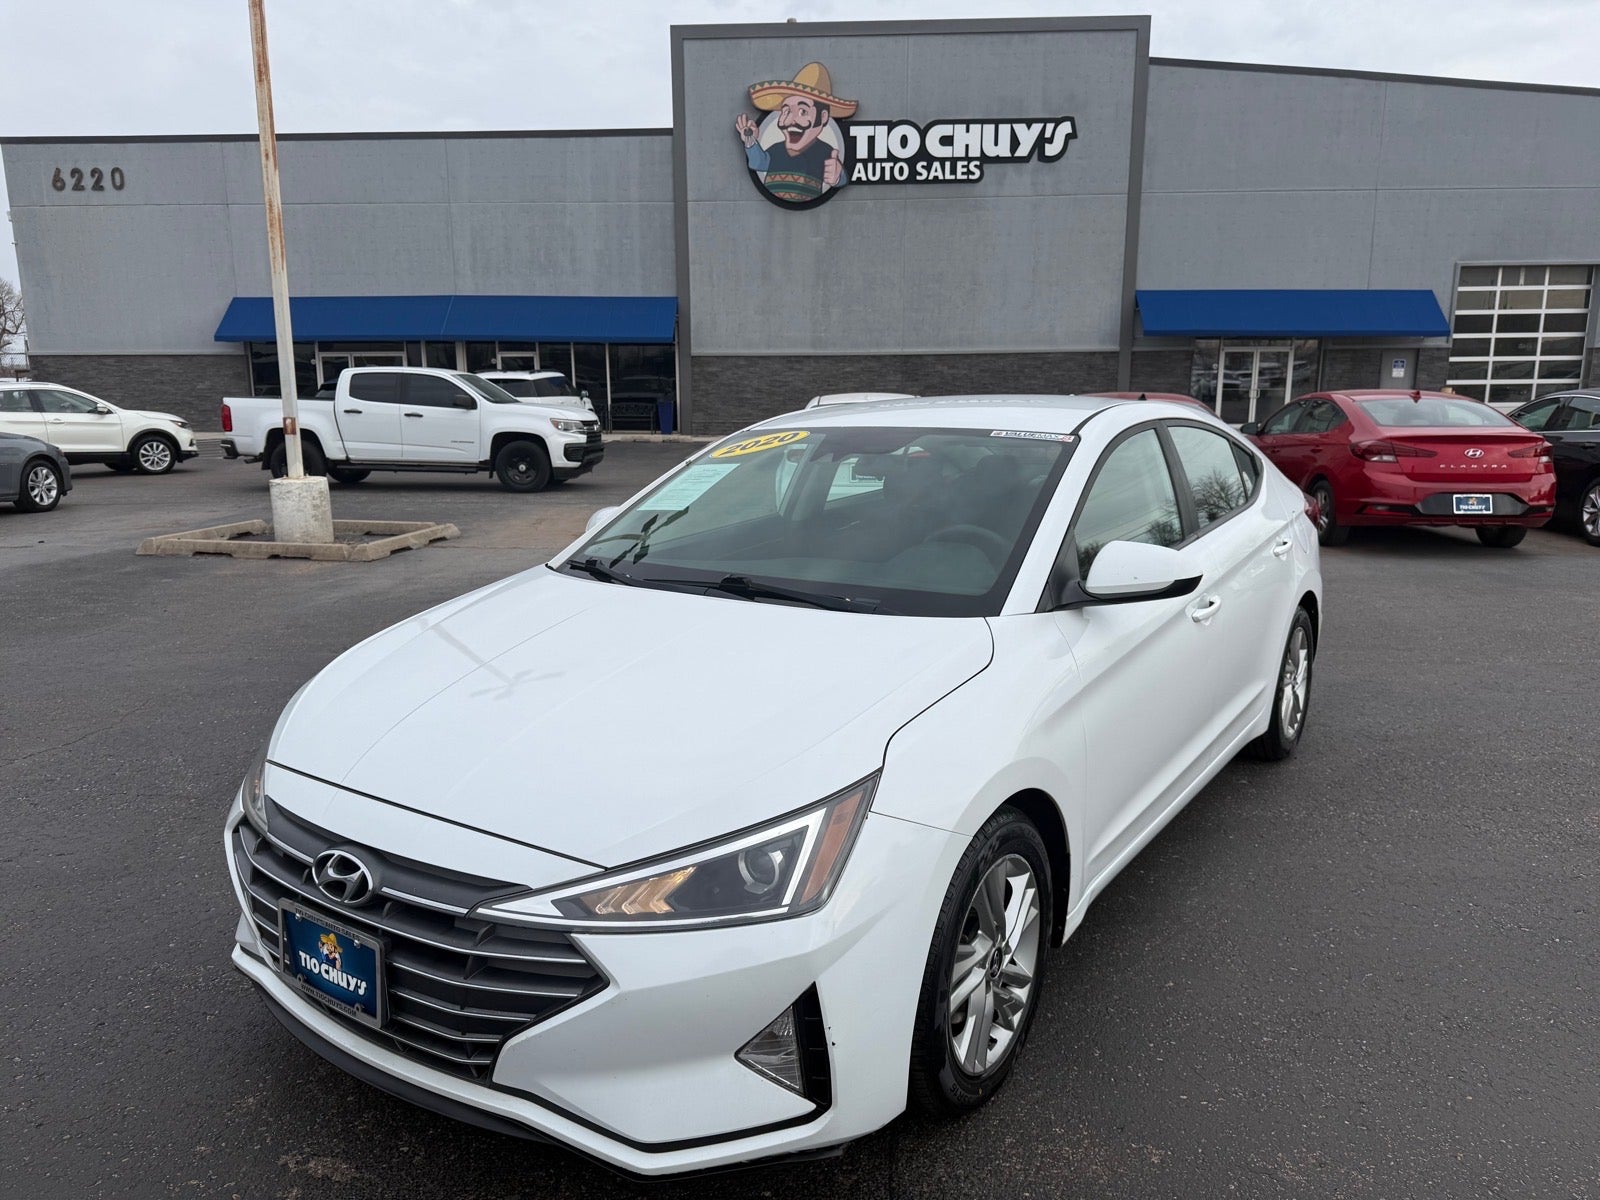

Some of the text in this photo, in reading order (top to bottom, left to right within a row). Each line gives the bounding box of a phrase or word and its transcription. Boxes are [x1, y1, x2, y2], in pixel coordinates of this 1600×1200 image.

[850, 121, 1073, 159] TIO CHUY'S
[52, 167, 125, 192] 6220
[851, 160, 981, 182] AUTO SALES
[718, 432, 801, 456] 2020
[298, 950, 367, 996] TIO CHUY'S
